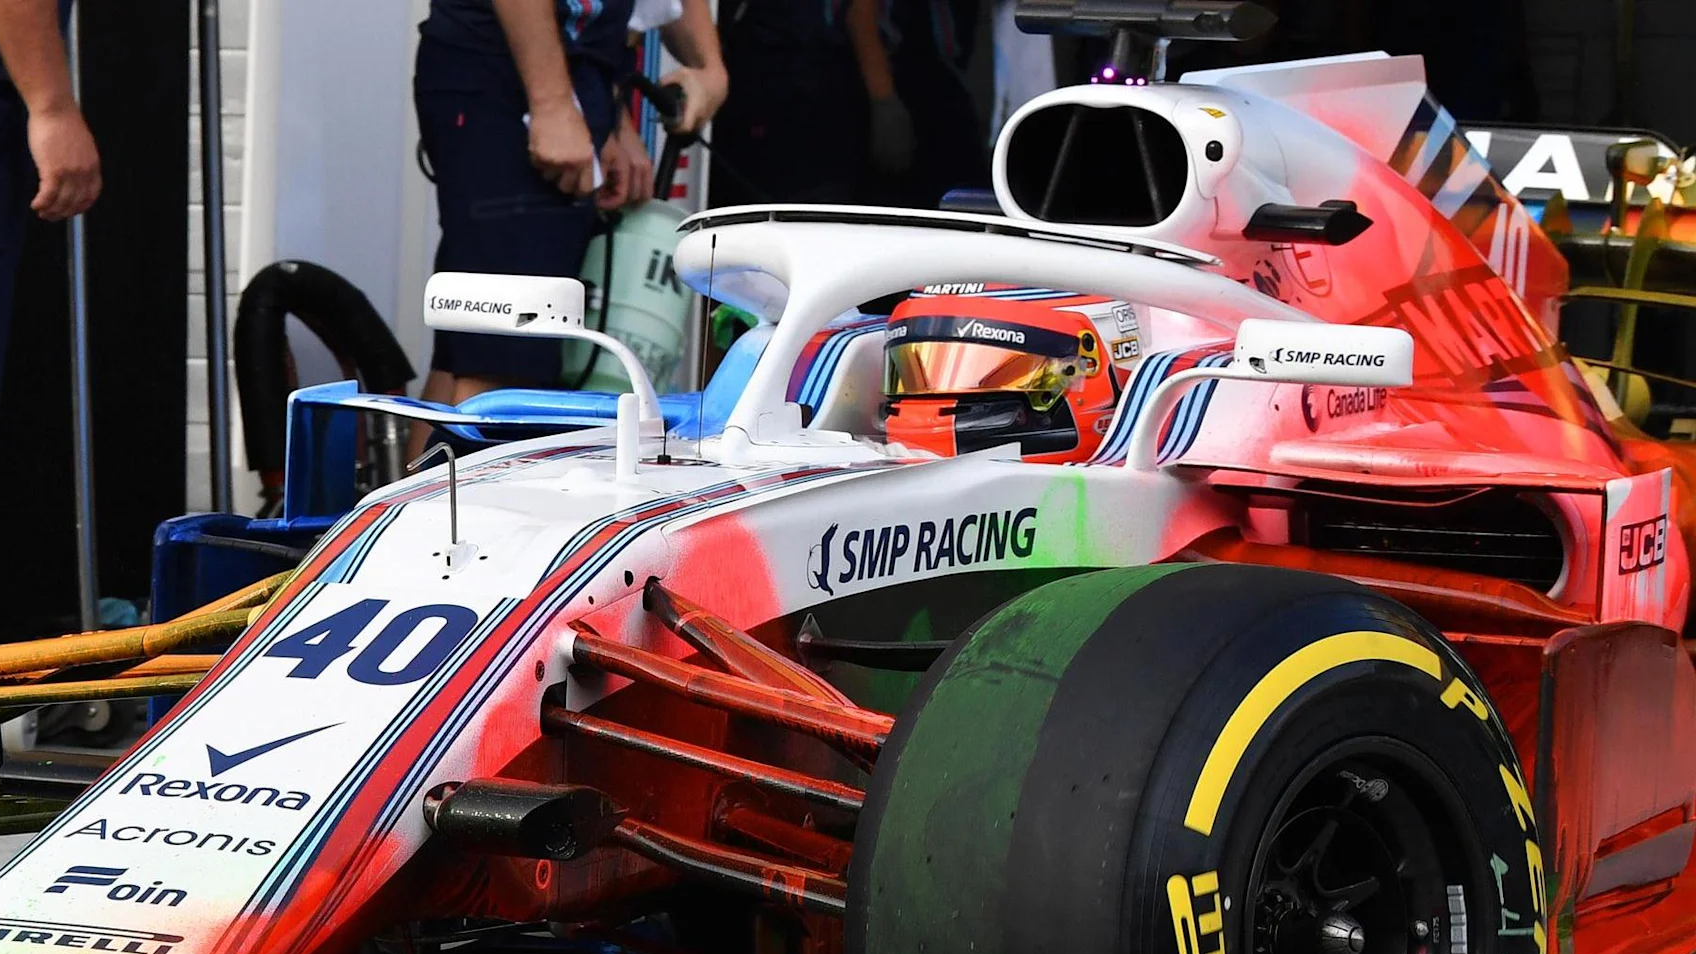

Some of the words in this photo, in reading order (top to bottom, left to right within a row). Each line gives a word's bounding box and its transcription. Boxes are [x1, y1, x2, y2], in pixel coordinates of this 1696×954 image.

[436, 298, 461, 311] SMP
[464, 300, 512, 315] RACING
[971, 322, 1026, 344] Rexona
[1400, 277, 1543, 376] MART
[1114, 340, 1139, 359] JCB
[1285, 350, 1321, 364] SMP
[1323, 353, 1385, 367] RACING
[1327, 387, 1365, 419] Canada
[839, 524, 910, 583] SMP
[913, 507, 1038, 573] RACING
[1620, 517, 1665, 570] JCB
[263, 598, 479, 686] 40
[119, 772, 312, 812] Rexona
[62, 818, 277, 857] Acronis
